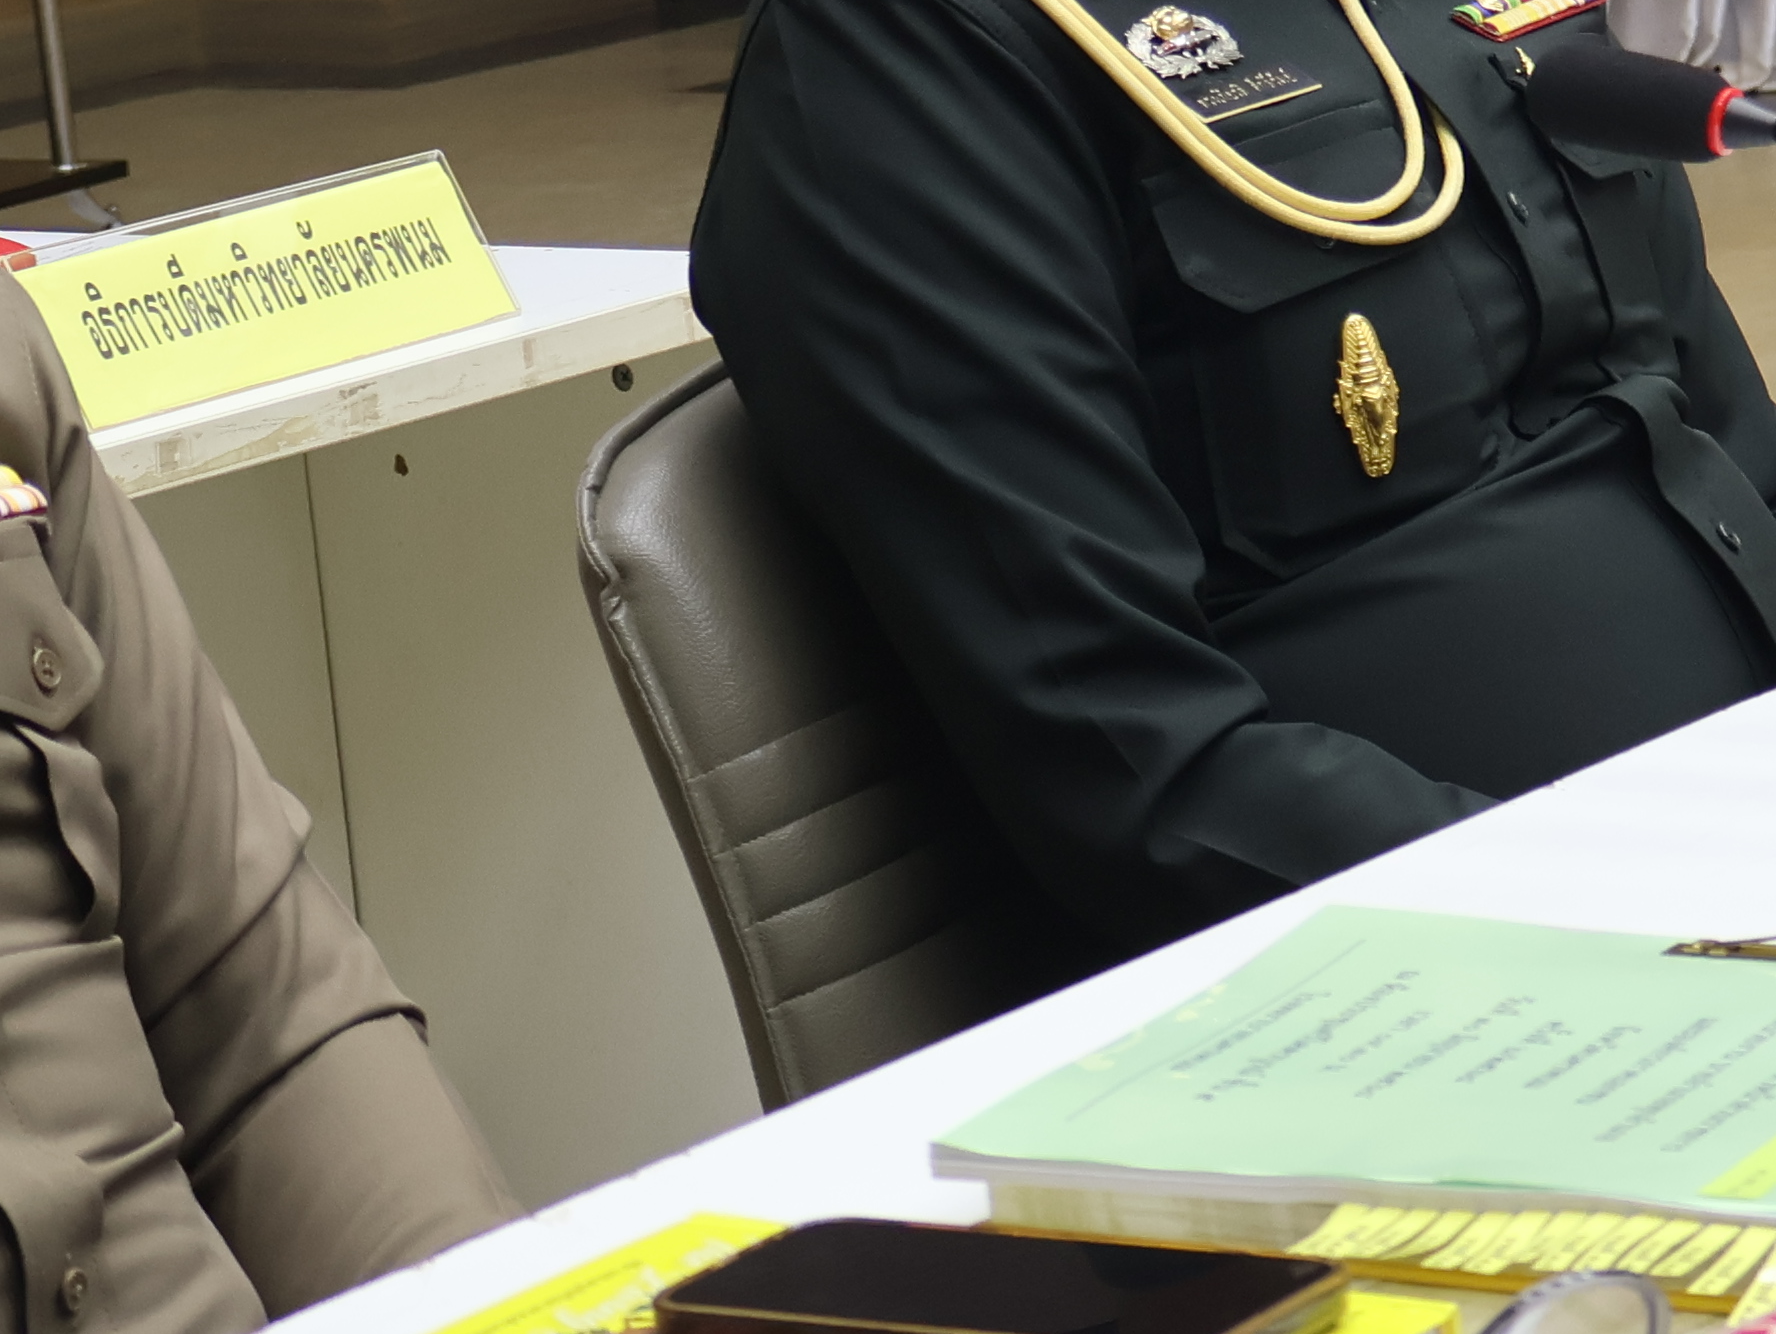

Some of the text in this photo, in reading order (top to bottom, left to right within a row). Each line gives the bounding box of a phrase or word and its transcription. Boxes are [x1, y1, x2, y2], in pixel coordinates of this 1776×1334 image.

[80, 217, 452, 360] อธิการบดีมหาวิทยาลัยนครพนม
